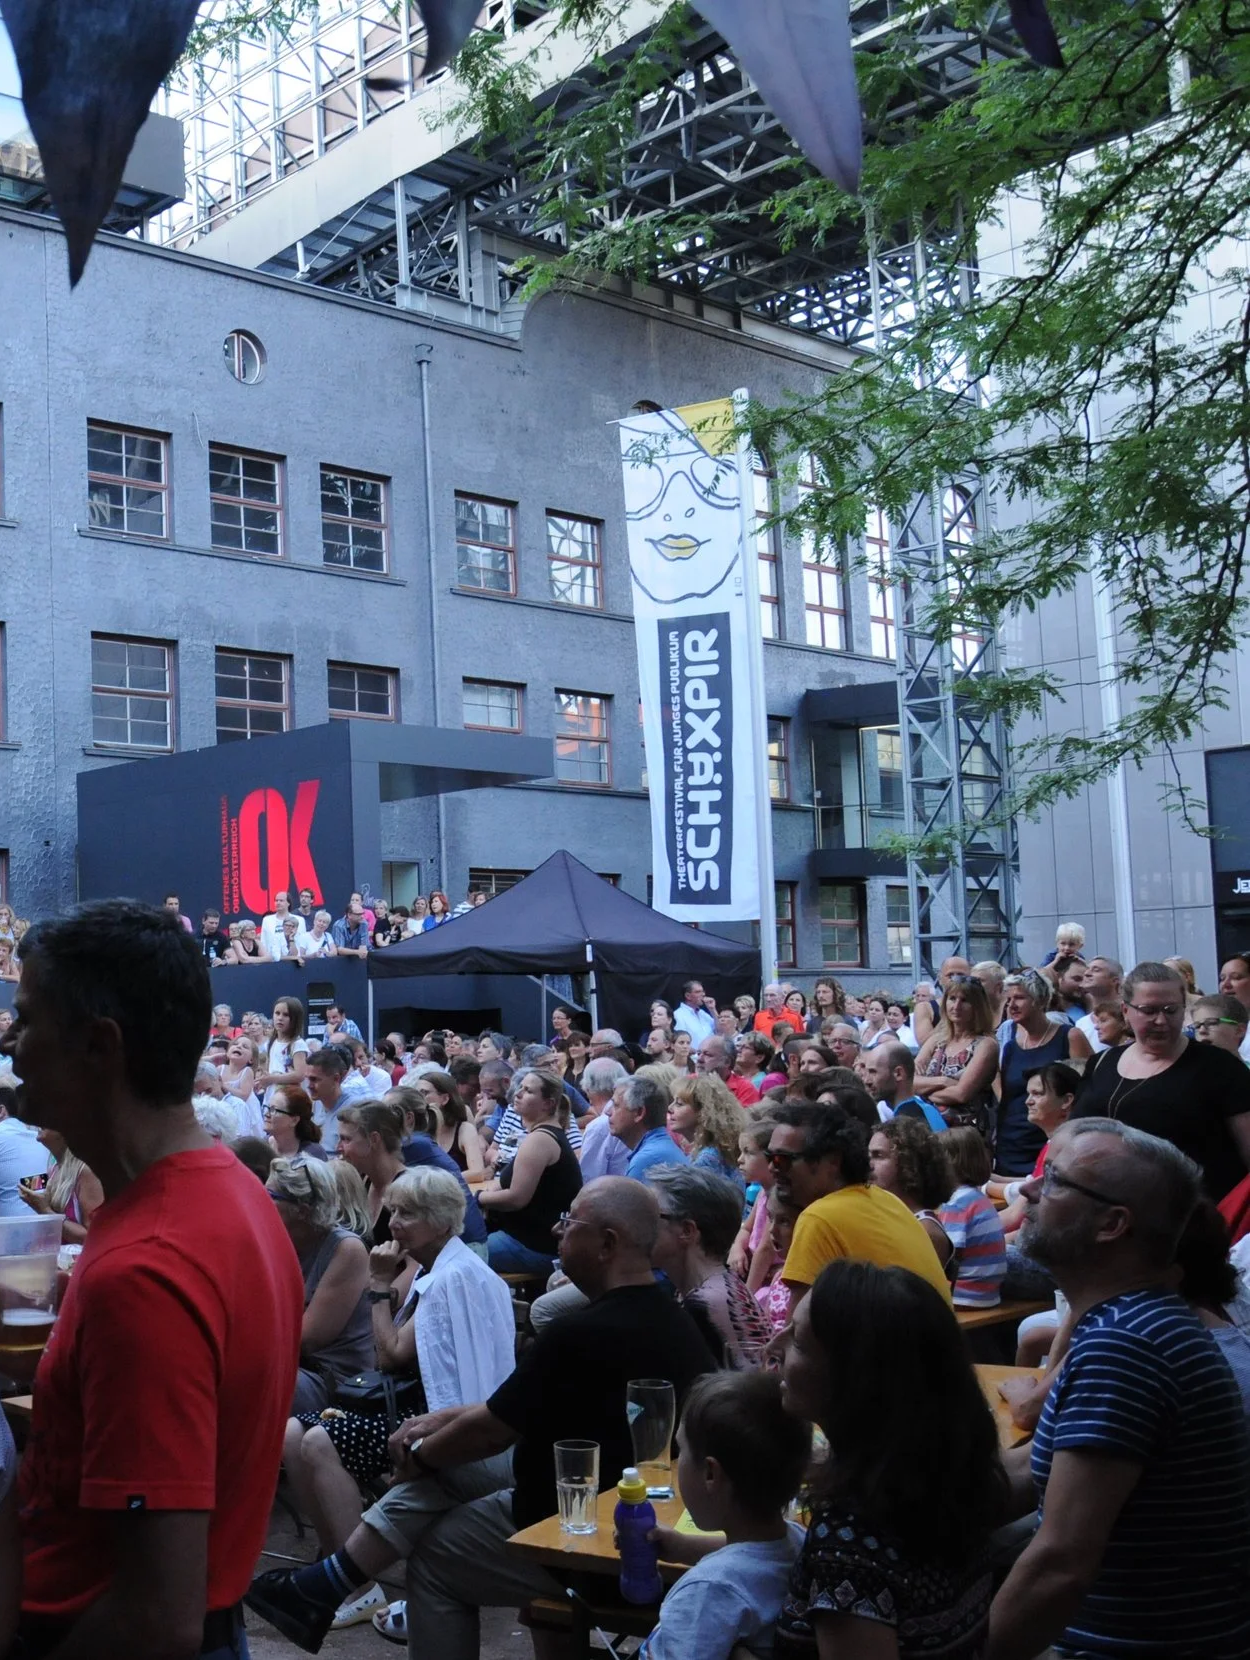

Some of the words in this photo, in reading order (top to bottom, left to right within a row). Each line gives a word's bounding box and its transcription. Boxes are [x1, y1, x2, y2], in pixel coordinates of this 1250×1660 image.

[668, 630, 680, 694] PUBLIKUM
[671, 695, 683, 746] JUNGES
[684, 628, 722, 892] SCHÄXPIR
[230, 818, 239, 914] OBERÖSTERREICH
[674, 773, 687, 890] THEATERFESTIVAL
[222, 866, 230, 915] OFFENES
